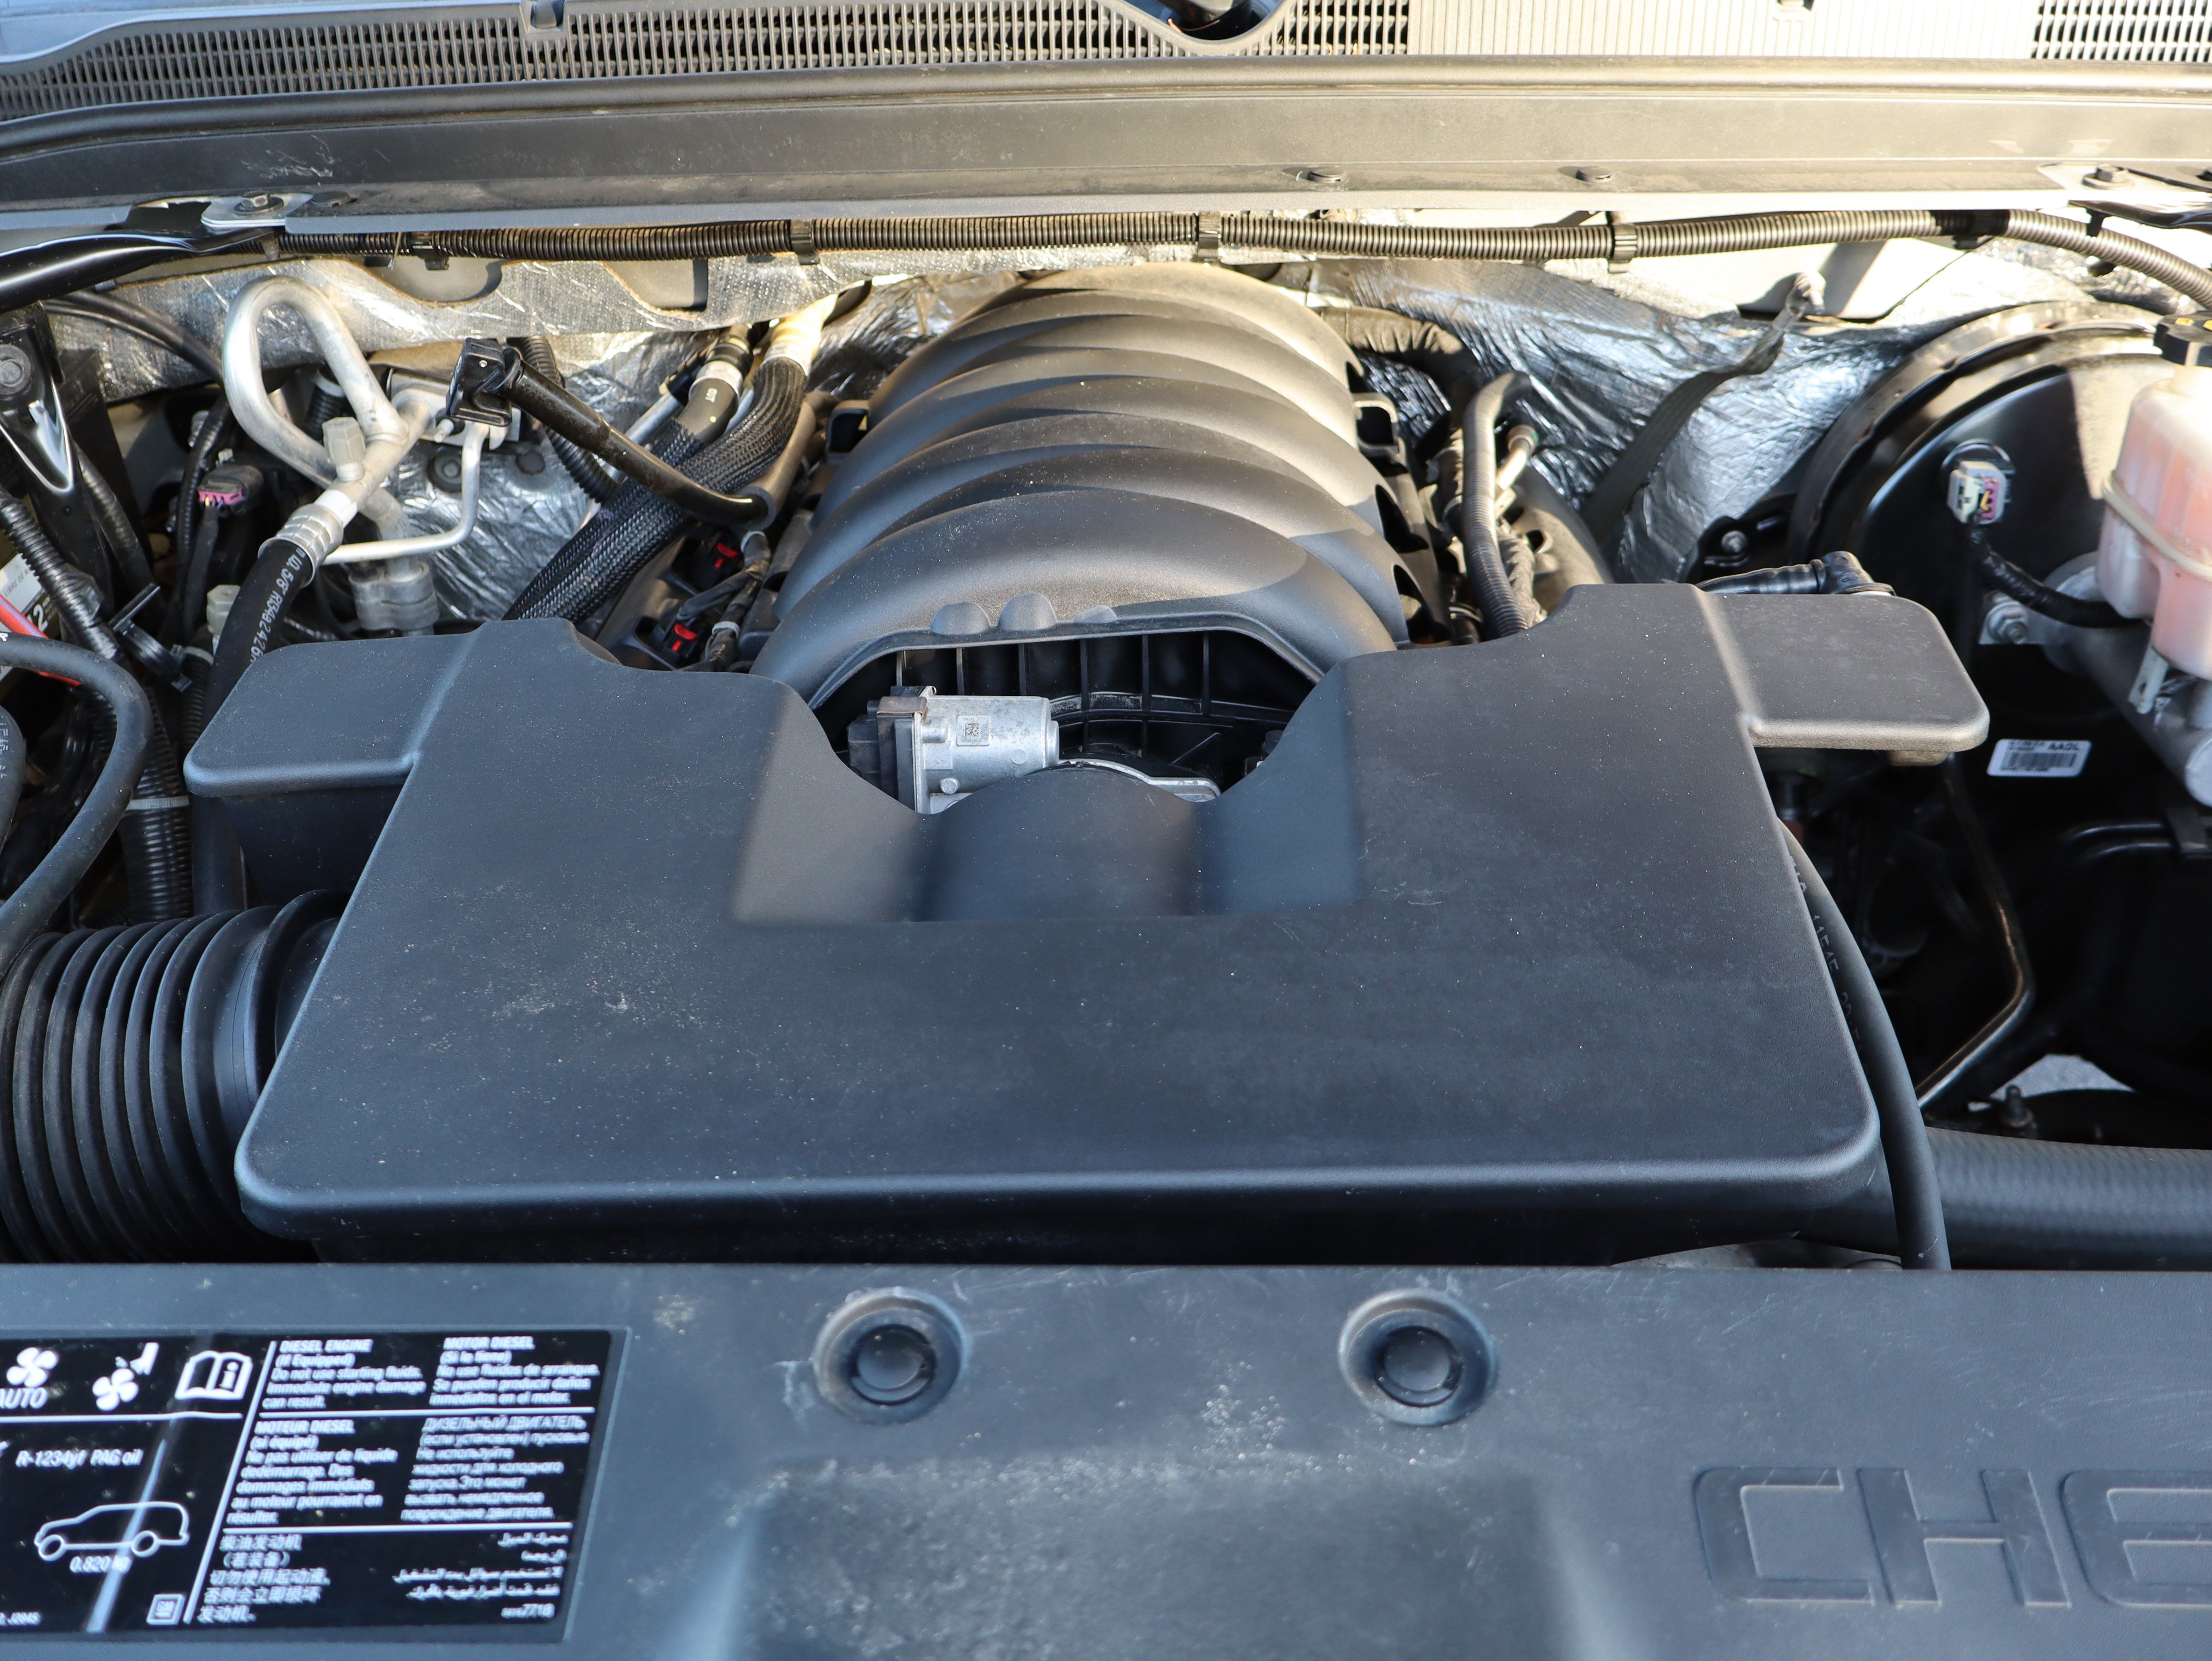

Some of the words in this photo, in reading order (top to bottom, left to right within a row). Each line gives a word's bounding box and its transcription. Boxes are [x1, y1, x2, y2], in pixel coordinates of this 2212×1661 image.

[279, 1340, 323, 1354] DIESEL
[324, 1339, 373, 1353] ENGINE
[443, 1337, 490, 1350] MOTOR
[490, 1336, 536, 1350] DIESEL
[271, 1367, 290, 1381] Do
[290, 1368, 313, 1381] not
[312, 1369, 337, 1381] use
[336, 1366, 385, 1382] starting
[262, 1398, 287, 1410] can
[254, 1420, 310, 1435] MOTEUR
[309, 1419, 355, 1434] DIESEL
[15, 1450, 88, 1470] R-1234yf
[90, 1449, 122, 1466] PAG
[122, 1449, 144, 1466] oil
[1693, 1466, 2212, 1608] CHE
[70, 1556, 111, 1573] 0.820
